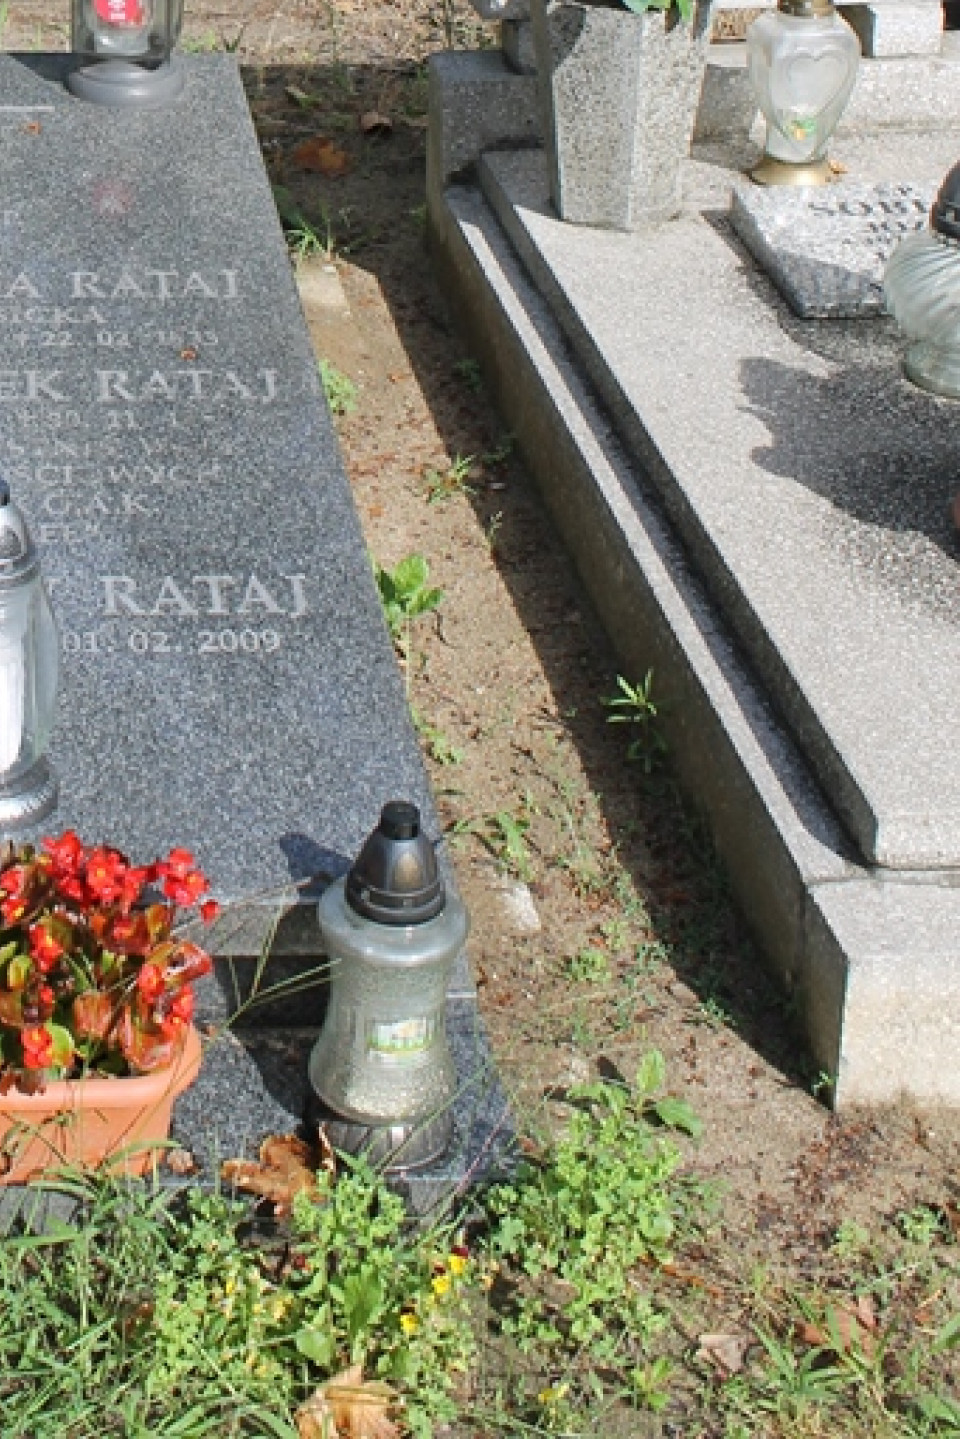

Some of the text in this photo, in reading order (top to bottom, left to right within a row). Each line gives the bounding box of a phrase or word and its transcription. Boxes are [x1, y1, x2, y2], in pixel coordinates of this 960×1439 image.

[69, 268, 241, 301] RATAJ
[94, 368, 279, 404] RATAJ
[99, 574, 307, 618] RATAJ
[197, 628, 282, 653] 2009
